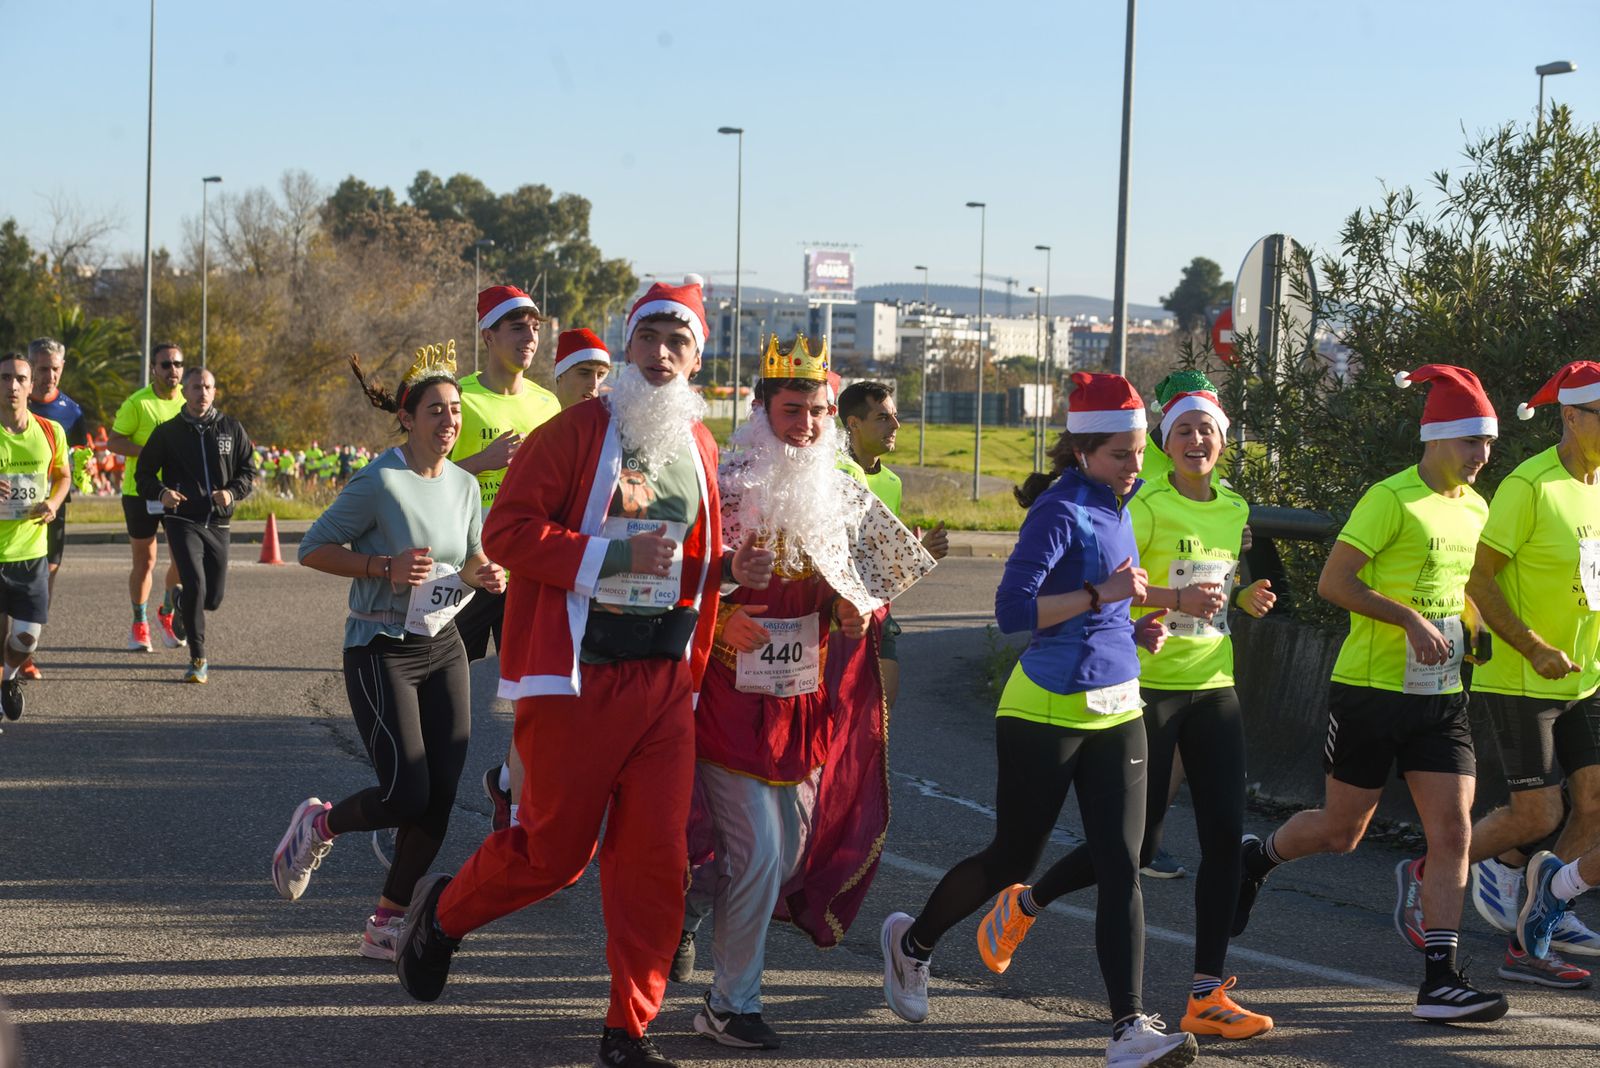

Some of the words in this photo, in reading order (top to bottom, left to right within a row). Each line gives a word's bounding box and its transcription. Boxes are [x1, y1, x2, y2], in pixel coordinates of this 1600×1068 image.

[412, 339, 456, 370] 2026
[1176, 539, 1199, 553] 41º
[1426, 537, 1445, 551] 41º
[1590, 562, 1600, 579] 1
[431, 585, 463, 608] 570
[761, 642, 802, 664] 440
